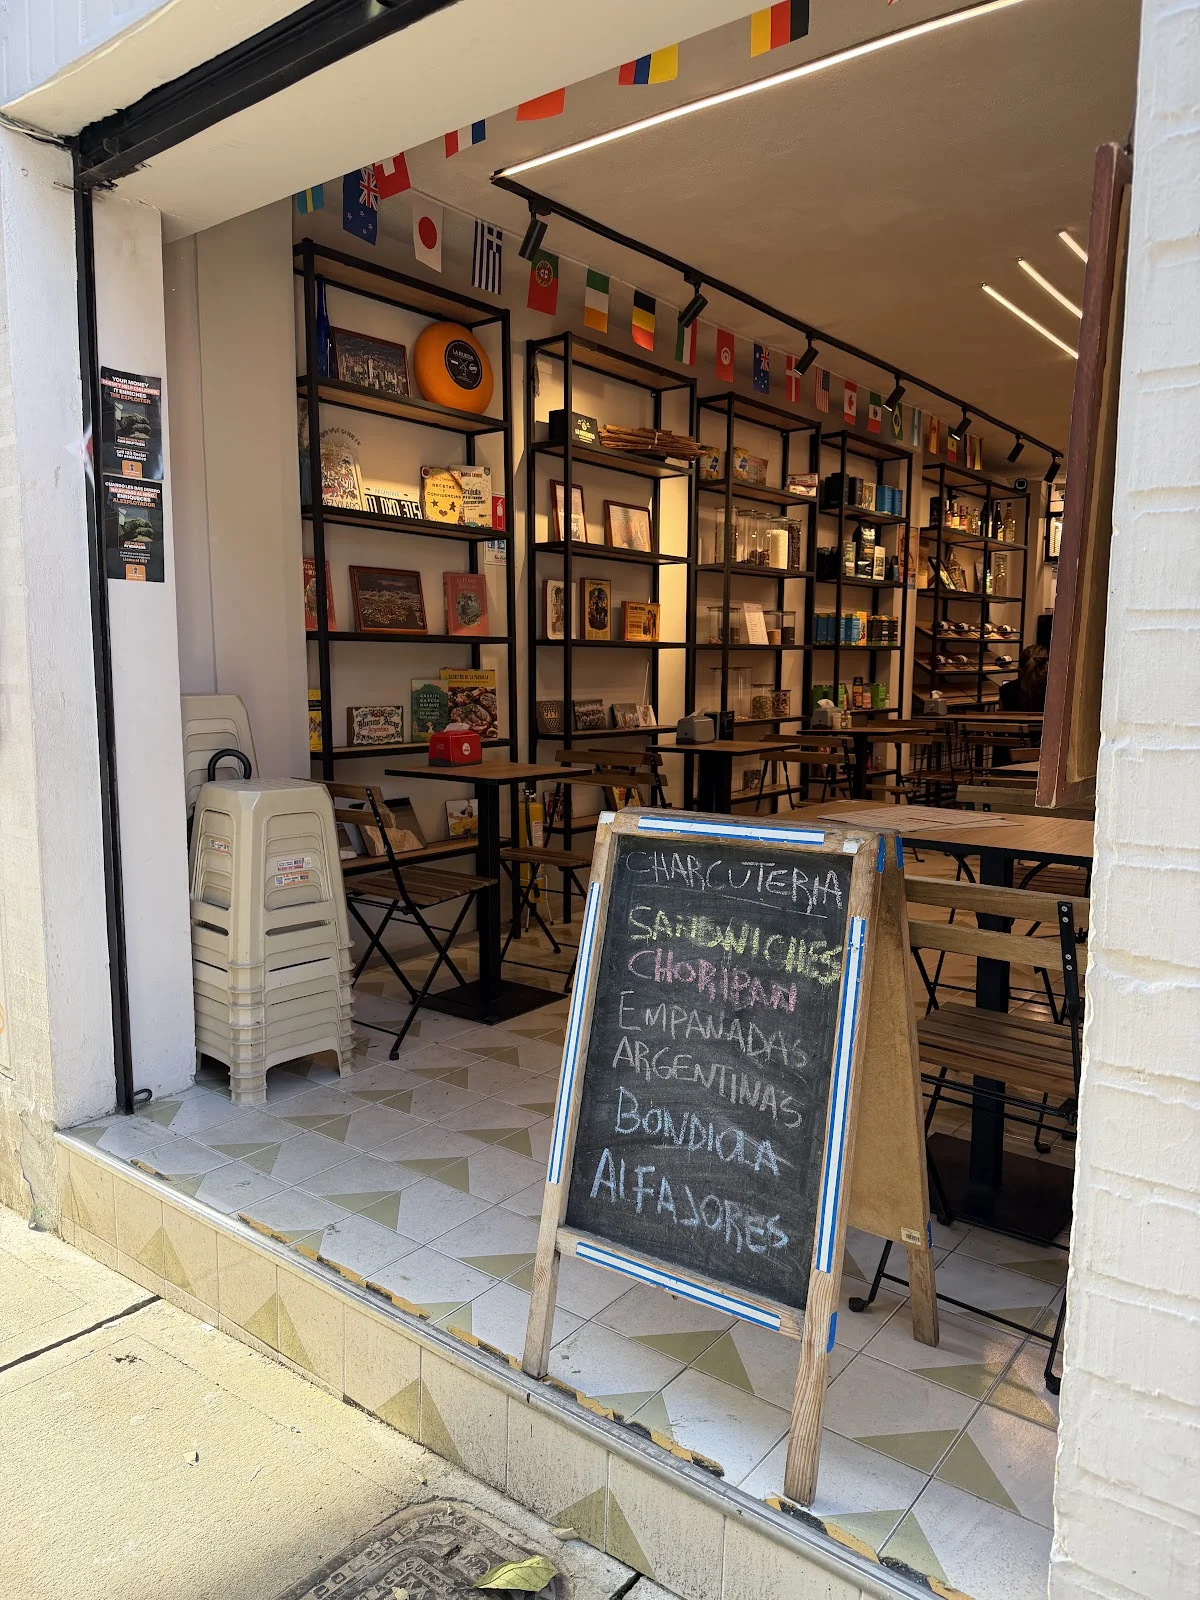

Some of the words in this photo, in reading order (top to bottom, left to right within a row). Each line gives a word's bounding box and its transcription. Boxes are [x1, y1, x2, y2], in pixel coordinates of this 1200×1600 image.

[112, 376, 127, 384] YOUR
[128, 380, 149, 388] MONEY
[122, 383, 133, 391] HELP
[118, 389, 147, 399] ENRICHES
[121, 395, 151, 405] EXPLOITER
[105, 481, 125, 489] CUANDO
[117, 493, 151, 502] ENRIQUECES
[427, 491, 461, 499] CONFIDENCIAS
[120, 499, 156, 508] EXPLOTADOR
[626, 851, 843, 914] CHARCUTERIA
[628, 905, 844, 985] SANDWICHES
[628, 948, 798, 1013] CHORIPAN
[618, 990, 808, 1068] EMPANADAS
[612, 1035, 802, 1128] ARGENTINAS
[615, 1086, 781, 1176] BONDIOLA
